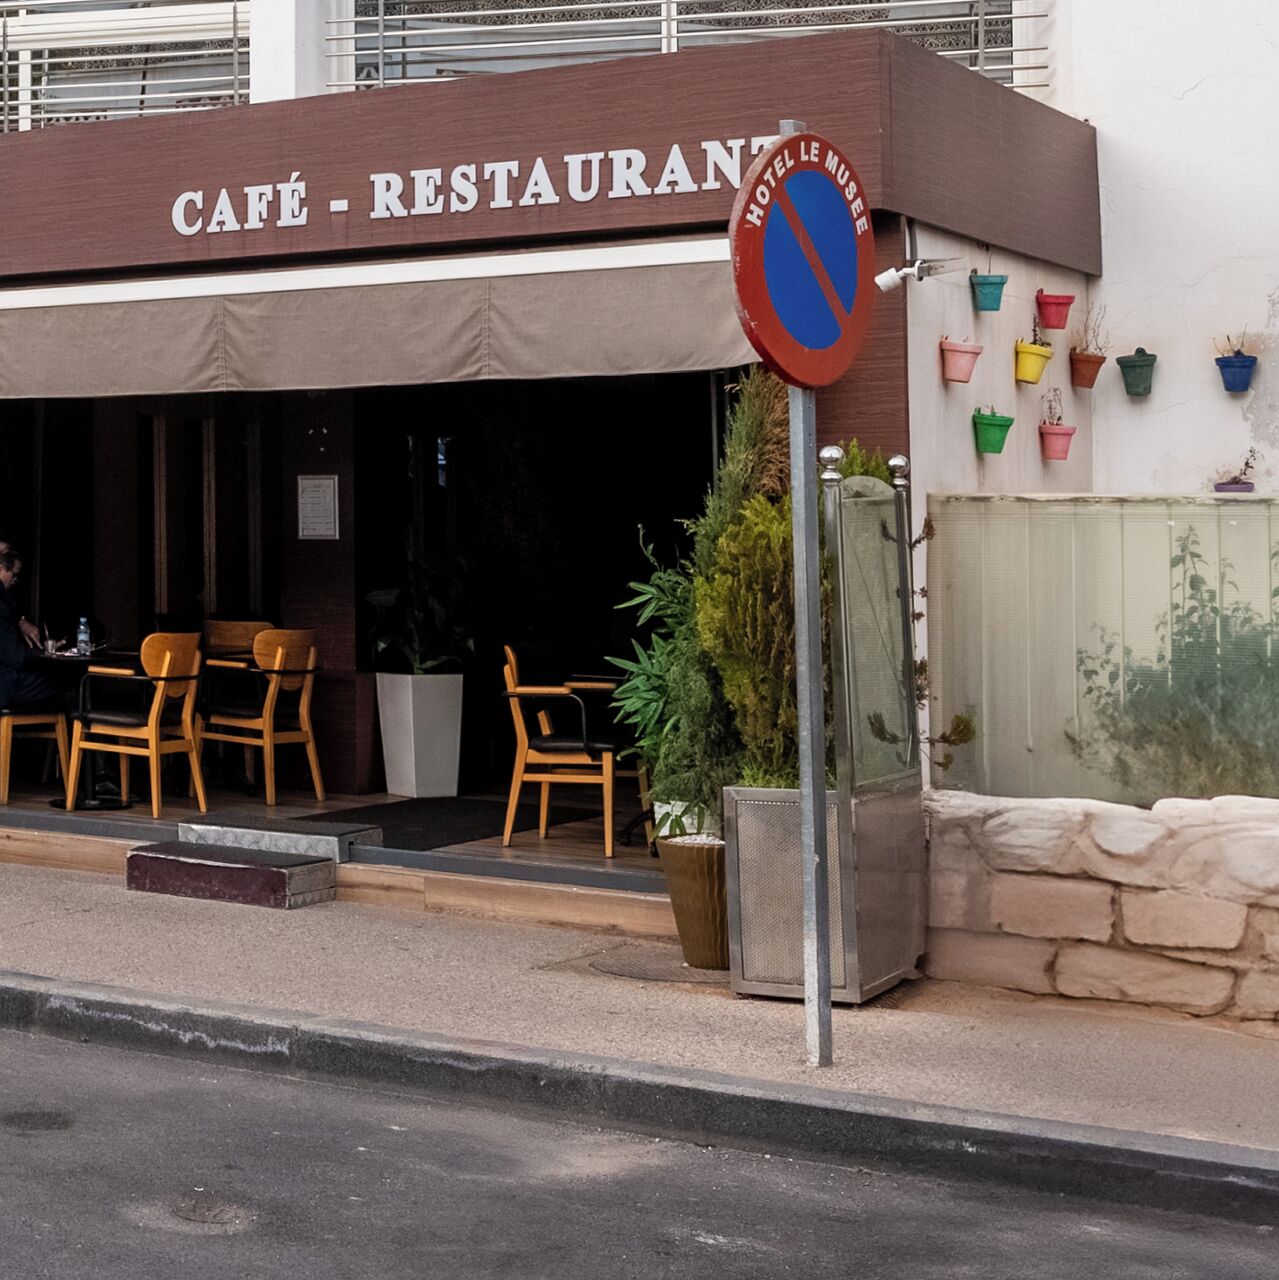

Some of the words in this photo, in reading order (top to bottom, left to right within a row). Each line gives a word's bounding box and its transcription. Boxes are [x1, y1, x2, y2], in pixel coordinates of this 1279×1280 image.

[171, 171, 308, 236] CAFÉ
[370, 134, 781, 220] RESTAURAN
[746, 149, 795, 228] HOTEL
[800, 141, 820, 163] LE
[824, 149, 869, 236] MUSEE
